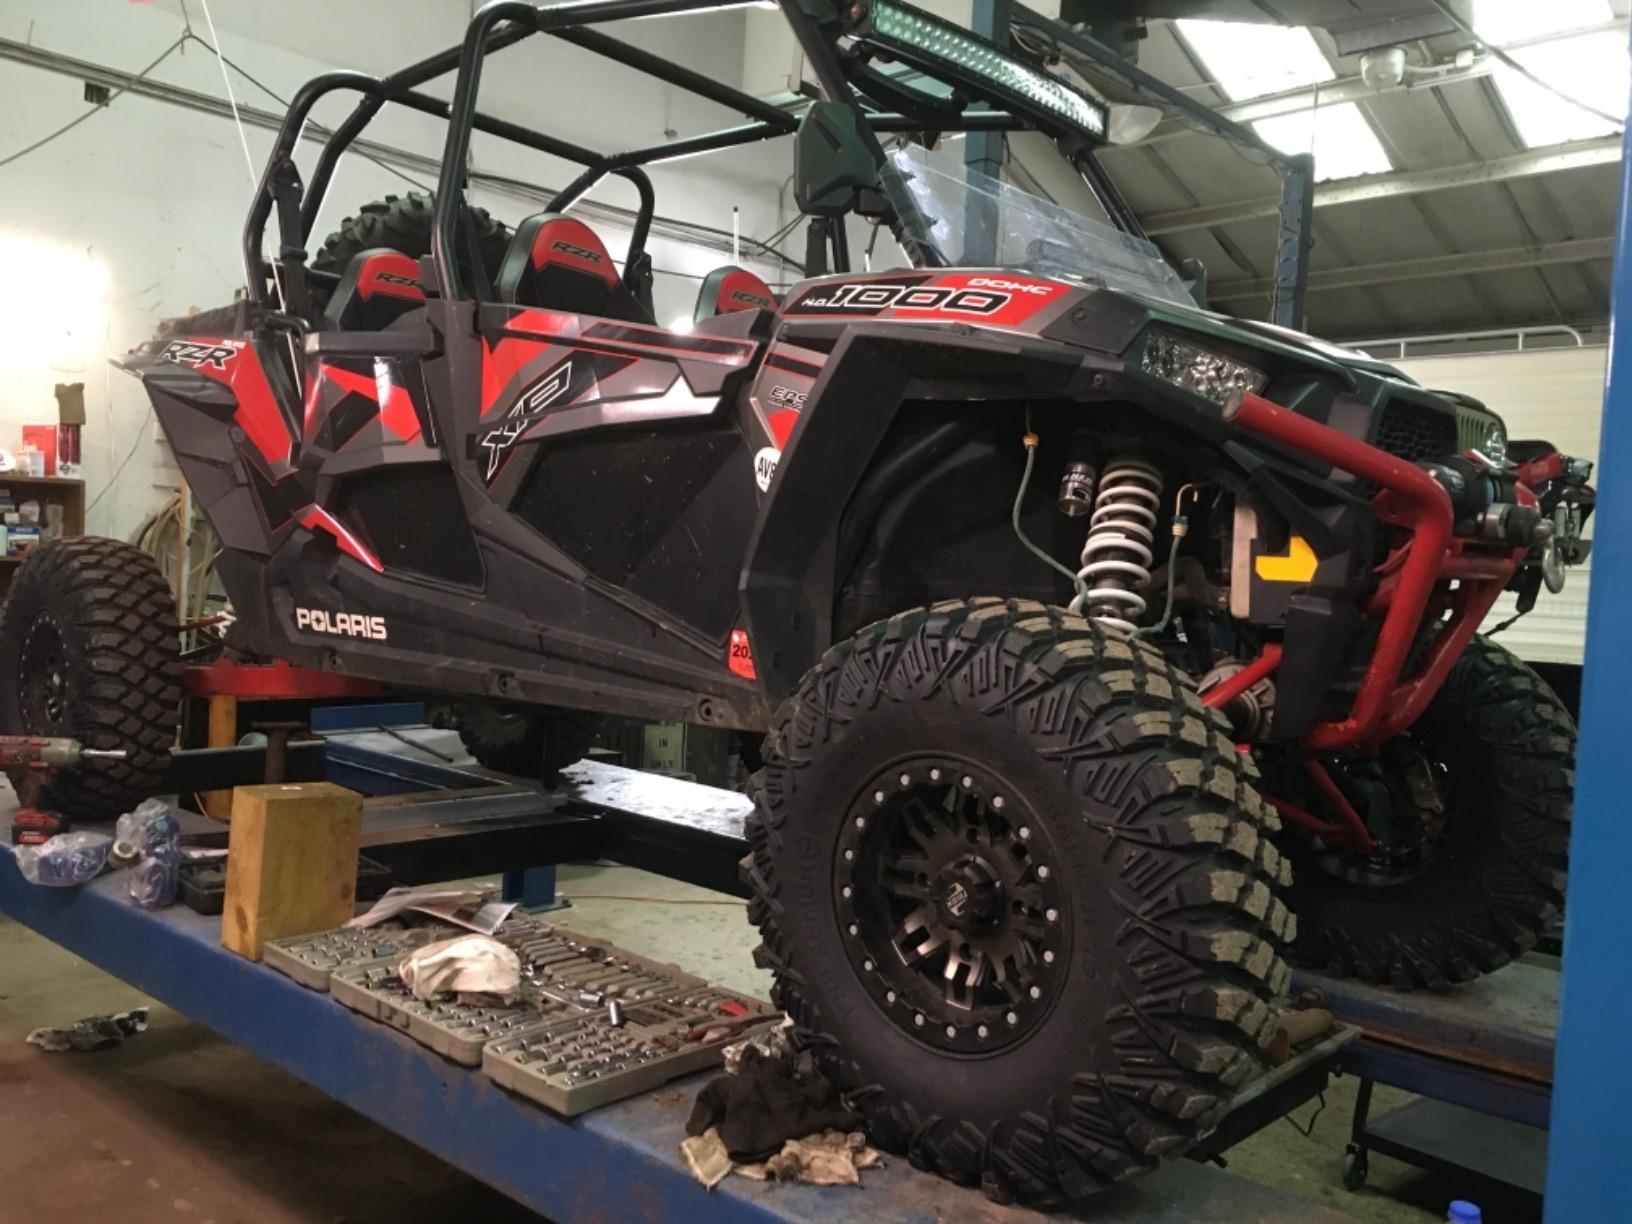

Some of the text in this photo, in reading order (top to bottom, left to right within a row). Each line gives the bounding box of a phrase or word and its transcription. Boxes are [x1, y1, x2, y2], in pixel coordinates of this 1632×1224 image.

[552, 240, 602, 262] RZR
[732, 291, 769, 306] RZR
[967, 278, 1053, 296] DOHC
[826, 284, 1012, 317] 1000
[156, 340, 237, 370] RZR
[481, 360, 573, 481] XP
[296, 607, 387, 640] POLARIS
[731, 644, 753, 660] 20
